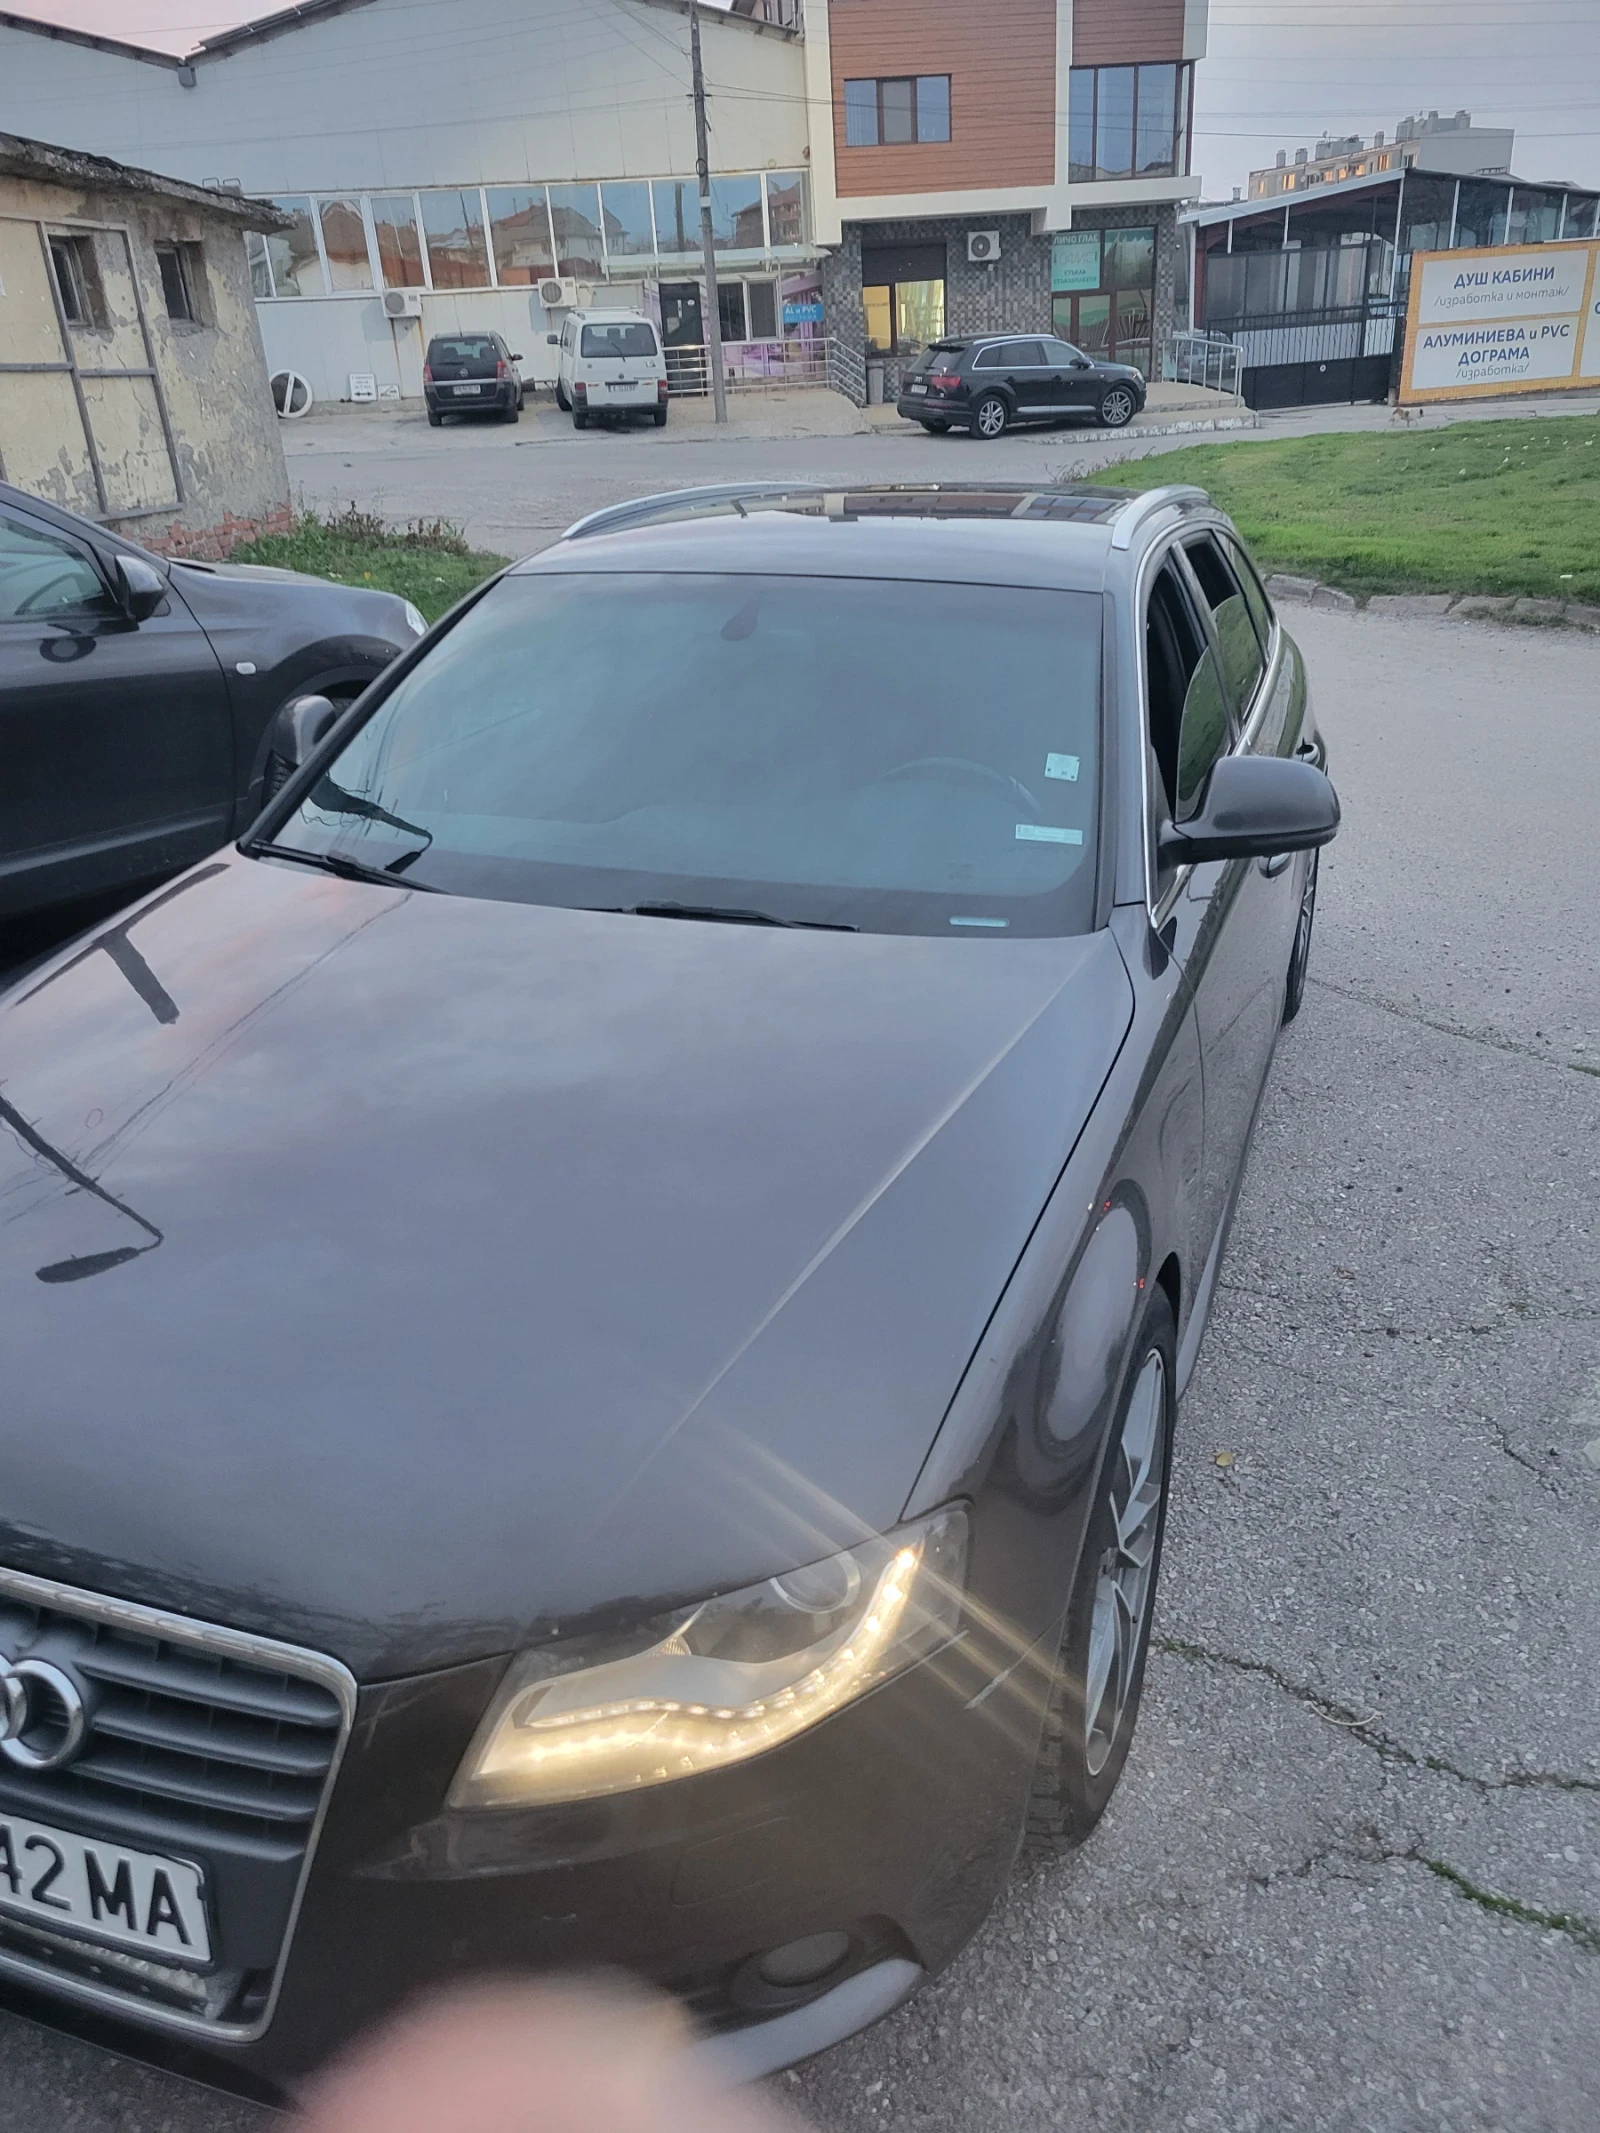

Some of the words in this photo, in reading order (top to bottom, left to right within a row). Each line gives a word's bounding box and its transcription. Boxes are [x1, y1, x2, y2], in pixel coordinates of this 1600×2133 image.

[1078, 233, 1099, 244] ГЛАС
[1059, 251, 1094, 265] ОФИС
[1454, 271, 1488, 289] ДУШ
[1492, 266, 1555, 284] КАБИНИ
[1434, 292, 1504, 309] /изработка
[1506, 293, 1513, 301] и
[1515, 286, 1570, 300] монтаж/
[1423, 328, 1525, 349] АЛУМИНИЕВА
[1529, 330, 1537, 340] и
[1541, 324, 1570, 339] PVC
[1458, 347, 1530, 366] ДОГРАМА
[1456, 362, 1530, 380] /изработка/
